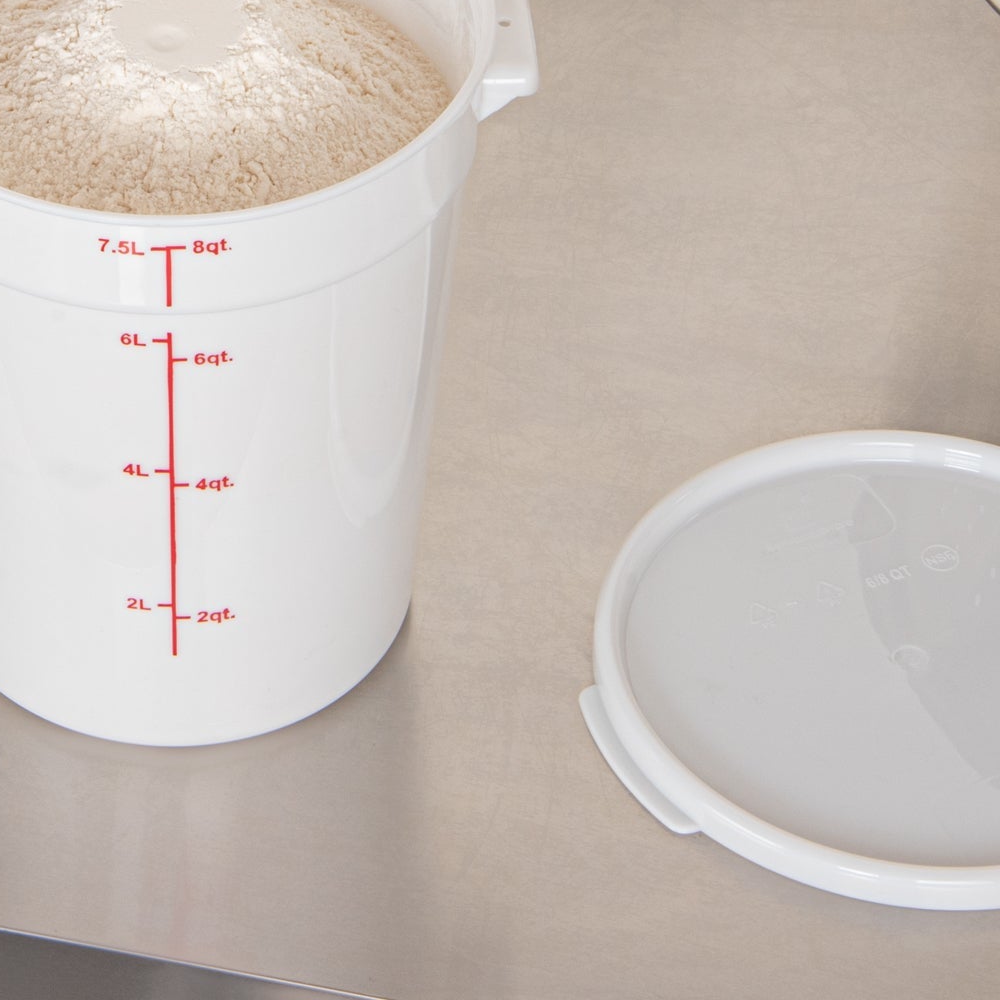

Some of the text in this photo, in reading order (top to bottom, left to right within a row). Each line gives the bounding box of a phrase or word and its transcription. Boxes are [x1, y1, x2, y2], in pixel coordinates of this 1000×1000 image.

[98, 237, 145, 256] 7.5L
[192, 239, 233, 255] 8qt.
[120, 333, 147, 347] 6L
[193, 350, 234, 366] 6qt.
[123, 463, 149, 477] 4L
[195, 476, 235, 491] 4qt.
[126, 597, 152, 611] 2L
[196, 607, 236, 623] 2qt.
